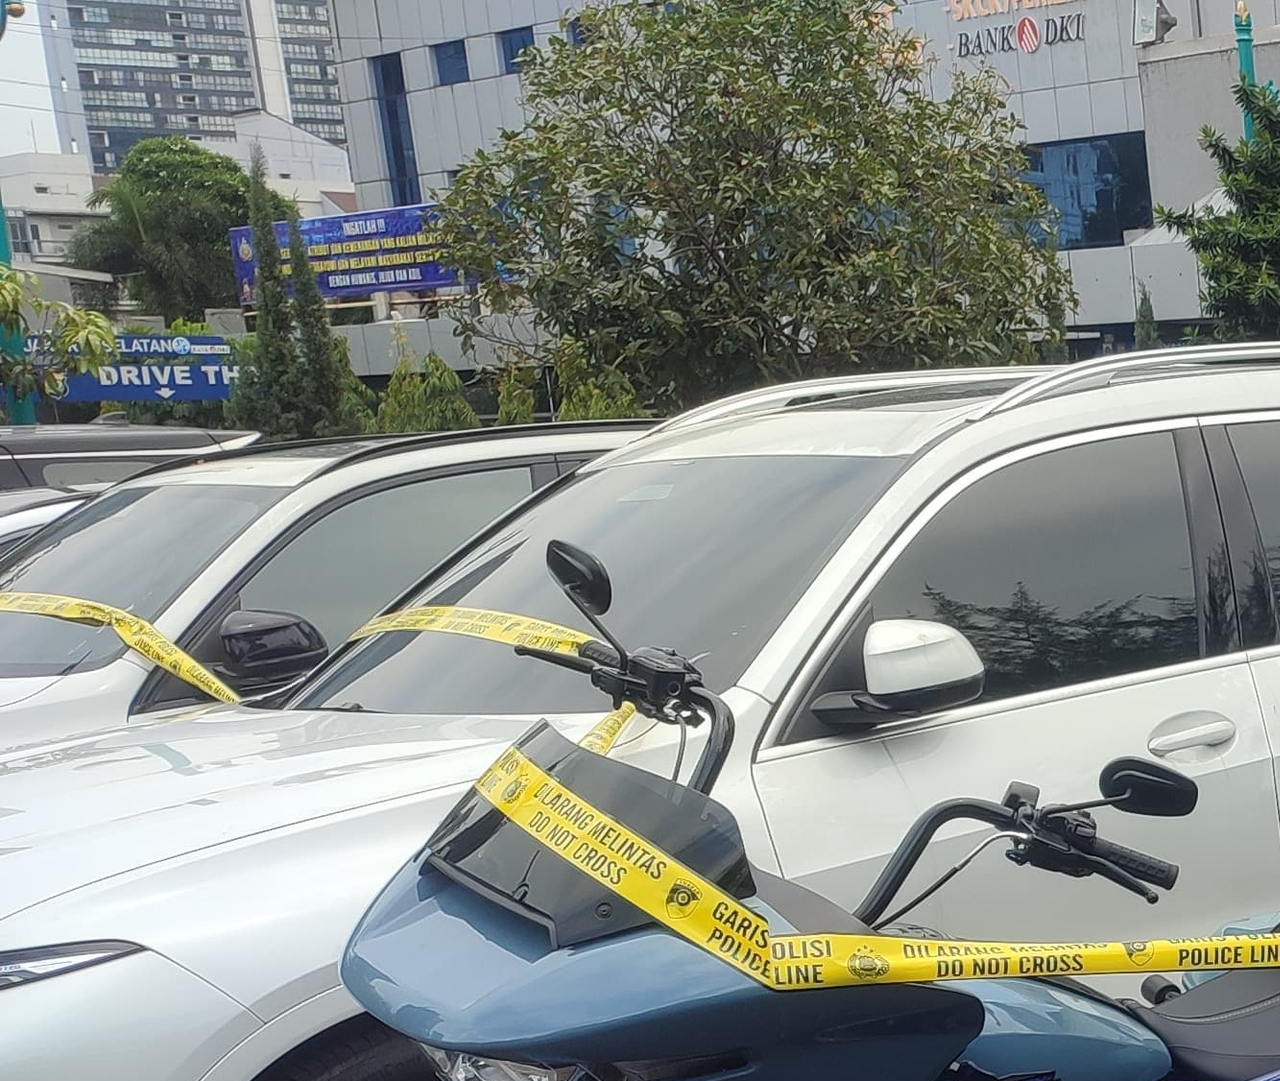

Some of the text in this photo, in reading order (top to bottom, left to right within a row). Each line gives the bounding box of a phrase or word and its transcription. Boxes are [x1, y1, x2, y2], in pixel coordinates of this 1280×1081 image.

[957, 24, 1016, 57] BANK
[1044, 13, 1084, 45] DKI
[99, 365, 240, 385] DRIVE TH
[533, 782, 667, 881] DILARANG MELINTAS
[529, 810, 628, 887] DO NOT CROSS
[711, 901, 770, 951] GARIS
[771, 940, 832, 961] OLISI
[1178, 946, 1244, 966] POLICE
[773, 963, 825, 985] LINE
[936, 953, 1084, 978] DO NOT CROSS
